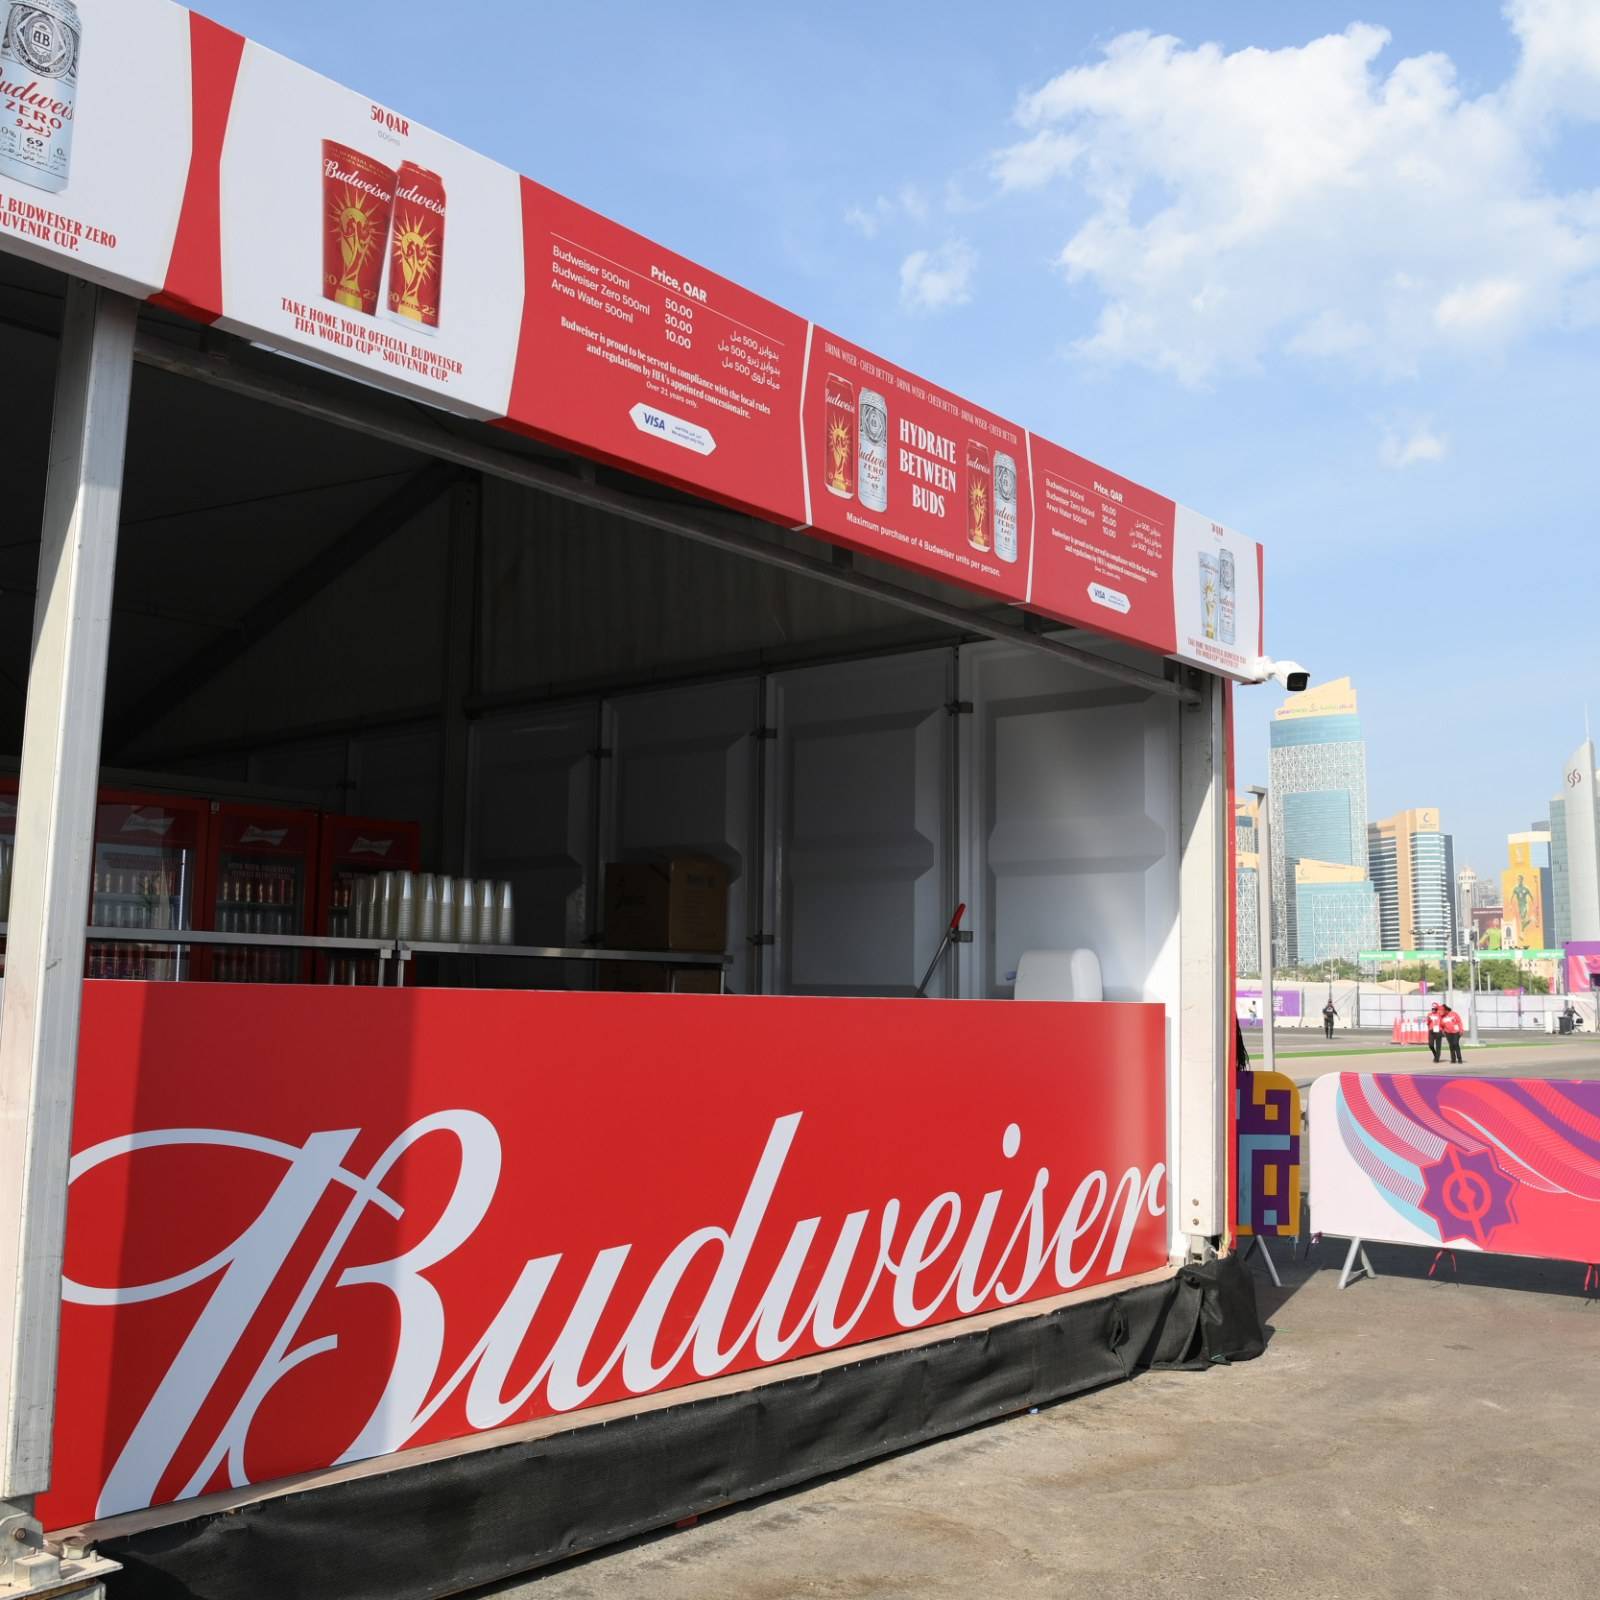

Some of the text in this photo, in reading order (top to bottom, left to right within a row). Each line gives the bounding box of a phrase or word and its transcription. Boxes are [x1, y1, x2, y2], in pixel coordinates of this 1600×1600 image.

[4, 98, 63, 129] ZERO
[371, 104, 409, 137] 50 QAR
[26, 137, 44, 148] 69
[322, 158, 392, 204] Budweiser
[0, 211, 79, 252] UVENIR CUP.
[8, 197, 82, 237] BUDWEISER
[85, 225, 117, 249] ZERO
[552, 261, 650, 316] Budweiser Zero 500ml
[553, 245, 630, 290] Budweiser 500ml
[651, 265, 707, 303] Price, QAR
[551, 278, 634, 324] Arwa Water 500ml
[665, 297, 693, 319] 50.00
[281, 297, 463, 375] TAKE HOME YOUR OFFICIAL BUDWEISER
[665, 313, 693, 335] 30.00
[665, 329, 691, 349] 10.00
[742, 335, 758, 350] 500
[294, 316, 315, 337] FIFA
[319, 325, 353, 348] WORLD
[382, 349, 428, 376] SOUVENIR
[430, 365, 449, 383] CUP.
[561, 315, 599, 341] Budweiser
[606, 338, 628, 353] proud
[629, 346, 637, 357] to
[637, 348, 647, 361] be
[646, 354, 669, 371] served
[669, 362, 677, 374] in
[677, 368, 714, 390] compliance
[714, 384, 729, 397] with
[729, 388, 740, 401] the
[740, 393, 755, 408] local
[755, 401, 771, 415] rules
[586, 343, 601, 356] and
[602, 350, 642, 373] regulations
[642, 364, 651, 378] by
[670, 380, 704, 399] appointed
[730, 345, 746, 359] 500
[734, 361, 750, 376] 500
[825, 342, 841, 359] DRINK
[841, 350, 857, 367] WISER
[860, 359, 875, 376] CHEER
[875, 368, 894, 385] BETTER
[896, 377, 911, 393] DRINK
[646, 381, 660, 392] Over
[660, 386, 668, 396] 21
[669, 391, 685, 403] years
[642, 411, 666, 431] VISA
[899, 417, 957, 465] HYDRATE
[899, 447, 957, 494] BETWEEN
[912, 484, 945, 518] BUDS
[846, 511, 879, 533] Maximum
[880, 525, 910, 544] purchase
[911, 536, 918, 546] of
[918, 539, 923, 549] 4
[924, 541, 955, 560] Budweiser
[955, 553, 970, 565] units
[970, 559, 981, 570] per
[62, 1107, 1166, 1521] Budweiser
